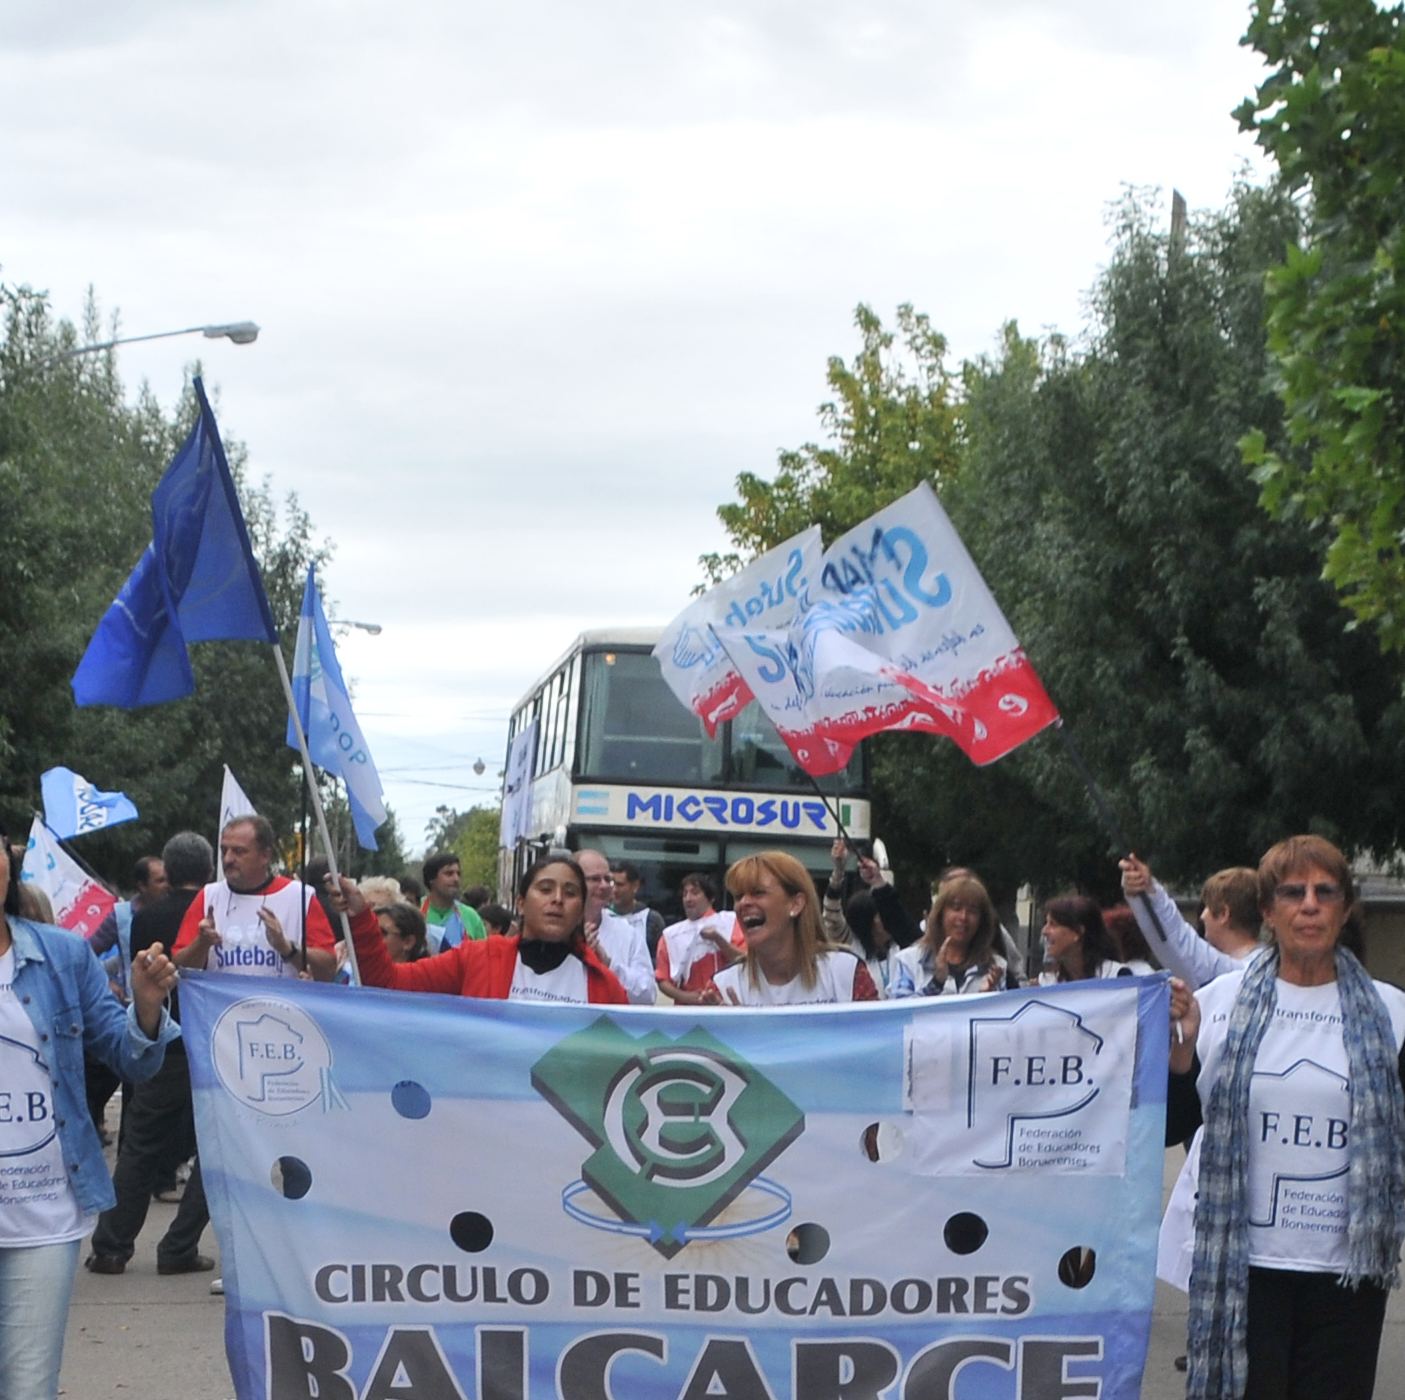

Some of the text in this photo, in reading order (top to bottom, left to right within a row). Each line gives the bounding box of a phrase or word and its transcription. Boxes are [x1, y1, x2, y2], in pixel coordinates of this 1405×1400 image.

[627, 792, 827, 830] MICROSUR
[249, 1042, 302, 1061] F.E.B.
[990, 1055, 1094, 1086] F.E.B.
[1019, 1127, 1082, 1139] Federación
[1018, 1142, 1034, 1153] de
[1282, 1203, 1297, 1215] de
[313, 1261, 1032, 1318] CIRCULO DE EDUCADORES
